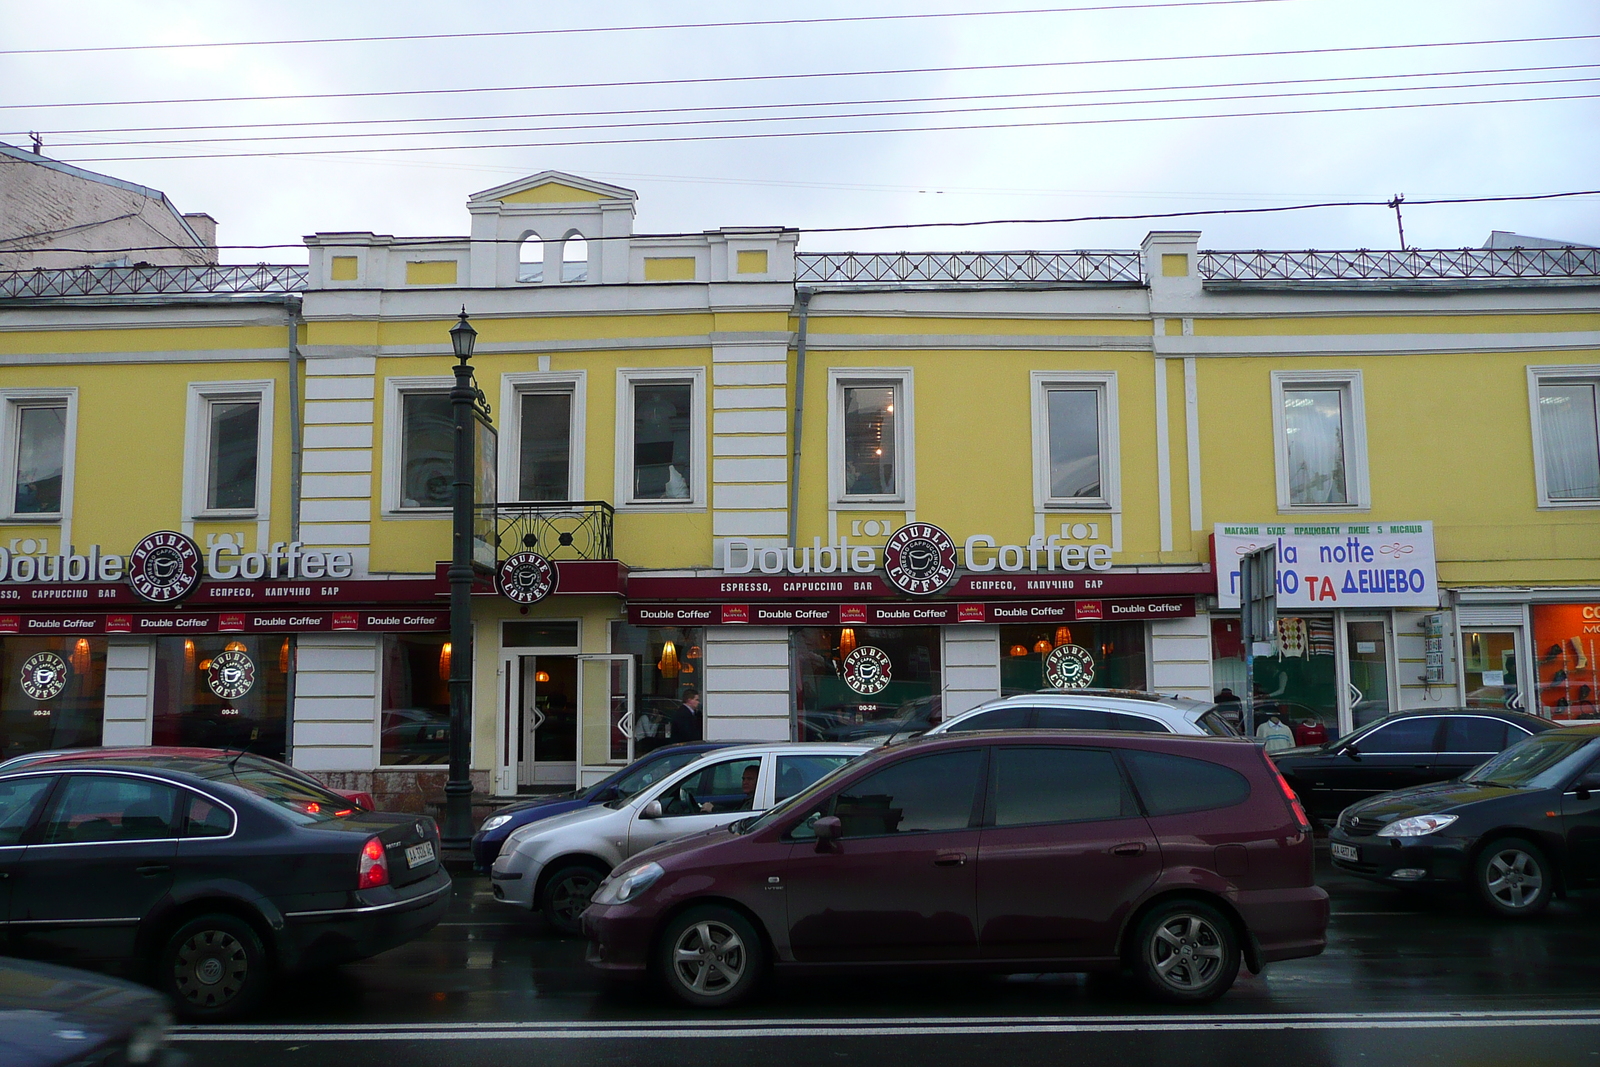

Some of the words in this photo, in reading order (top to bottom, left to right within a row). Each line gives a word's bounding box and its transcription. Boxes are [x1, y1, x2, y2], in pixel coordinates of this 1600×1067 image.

[890, 526, 950, 552] DOUBLE
[1224, 527, 1259, 535] МАГАЗИН
[1266, 527, 1286, 536] БУДЕ
[1294, 526, 1340, 536] ПРАЦЮВАТИ
[1348, 526, 1370, 534] ЛИШЕ
[1377, 525, 1383, 534] 5
[1390, 525, 1423, 534] МІСЯЦІВ
[135, 534, 193, 559] DOUBLE
[723, 536, 876, 574] Double
[964, 534, 1113, 572] Coffee
[1277, 537, 1298, 564] la
[1319, 537, 1374, 563] notte
[208, 541, 352, 580] Coffee
[505, 555, 548, 573] DOUBLE
[134, 573, 193, 599] COFFEE
[720, 582, 772, 593] ESPRESSO,
[783, 582, 843, 591] CAPPUCCINO
[853, 581, 873, 591] BAR
[890, 565, 951, 592] COFFEE
[970, 580, 1017, 591] ЕСПРЕСО,
[1027, 580, 1074, 589] КАПУЧІНО
[1085, 579, 1103, 588] БАР
[1304, 575, 1337, 602] ТА
[1341, 568, 1425, 593] ДЕШЕВО
[31, 589, 88, 599] CAPPUCCINO
[98, 589, 117, 598] BAR
[210, 587, 255, 598] ЕСПРЕСО,
[265, 587, 311, 596] КАПУЧІНО
[321, 586, 340, 596] БАР
[504, 582, 548, 602] COFFEE
[640, 610, 674, 619] Double
[677, 610, 709, 619] Coffee
[758, 609, 792, 619] Double
[795, 609, 827, 619] Coffee
[876, 609, 910, 619] Double
[913, 609, 945, 618] Coffee
[994, 608, 1028, 617] Double
[1030, 607, 1063, 616] Coffee
[1111, 604, 1146, 614] Double
[1148, 603, 1180, 613] Coffee
[28, 619, 61, 628] Double
[63, 619, 94, 628] Coffee
[140, 619, 173, 627] Double
[175, 618, 208, 627] Coffee
[253, 617, 287, 626] Double
[289, 617, 320, 625] Coffee
[367, 616, 400, 625] Double
[403, 616, 435, 625] Coffee
[25, 654, 64, 671] DOUBLE
[212, 653, 251, 670] DOUBLE
[847, 648, 888, 665] DOUBLE
[1050, 646, 1090, 664] DOUBLE
[23, 680, 63, 698] COFFEE
[211, 679, 251, 697] COFFEE
[847, 675, 889, 693] COFFEE
[1050, 673, 1091, 689] COFFEE
